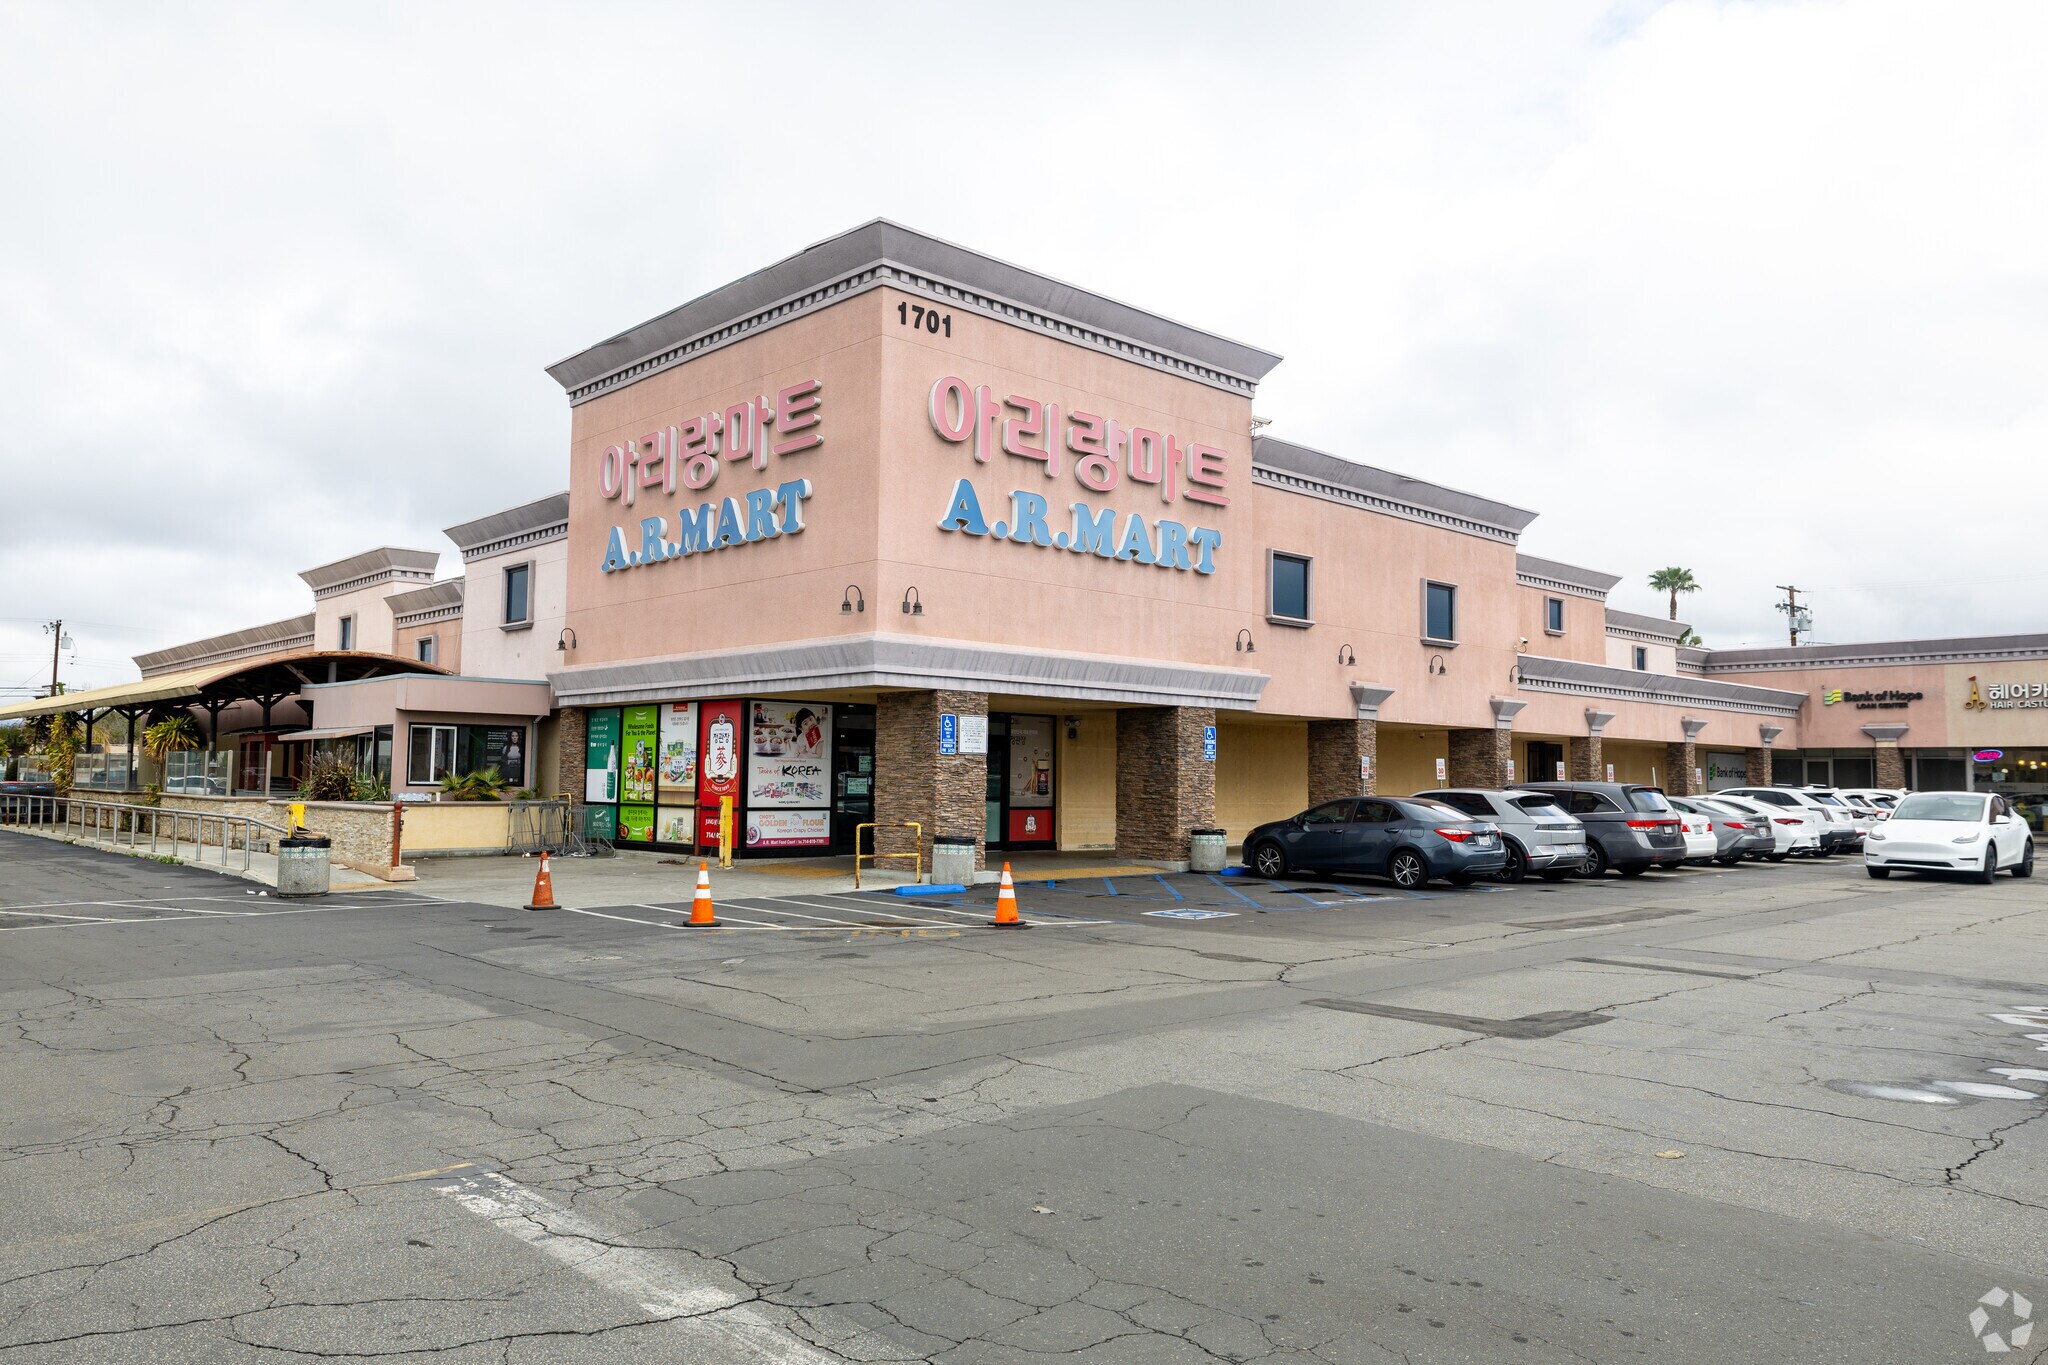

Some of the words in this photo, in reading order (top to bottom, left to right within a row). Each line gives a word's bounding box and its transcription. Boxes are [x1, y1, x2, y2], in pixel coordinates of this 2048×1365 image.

[898, 301, 951, 338] 1701
[599, 379, 825, 507] 아리랑마트
[928, 376, 1231, 506] 아리랑마트
[601, 478, 813, 573] A.R.MART
[937, 478, 1223, 575] A.R.MART
[1843, 691, 1873, 702] Bank
[1875, 690, 1888, 701] of
[1889, 690, 1923, 702] Hope
[1990, 701, 2014, 709] HAIR
[713, 732, 730, 744] 정관장
[1976, 751, 1999, 760] OPEN
[757, 766, 772, 775] Taste
[773, 766, 780, 776] of
[781, 764, 822, 779] KOREA
[1716, 766, 1728, 778] Bank
[1729, 767, 1734, 778] of
[1734, 767, 1747, 780] Hope
[759, 819, 787, 827] GOLDEN
